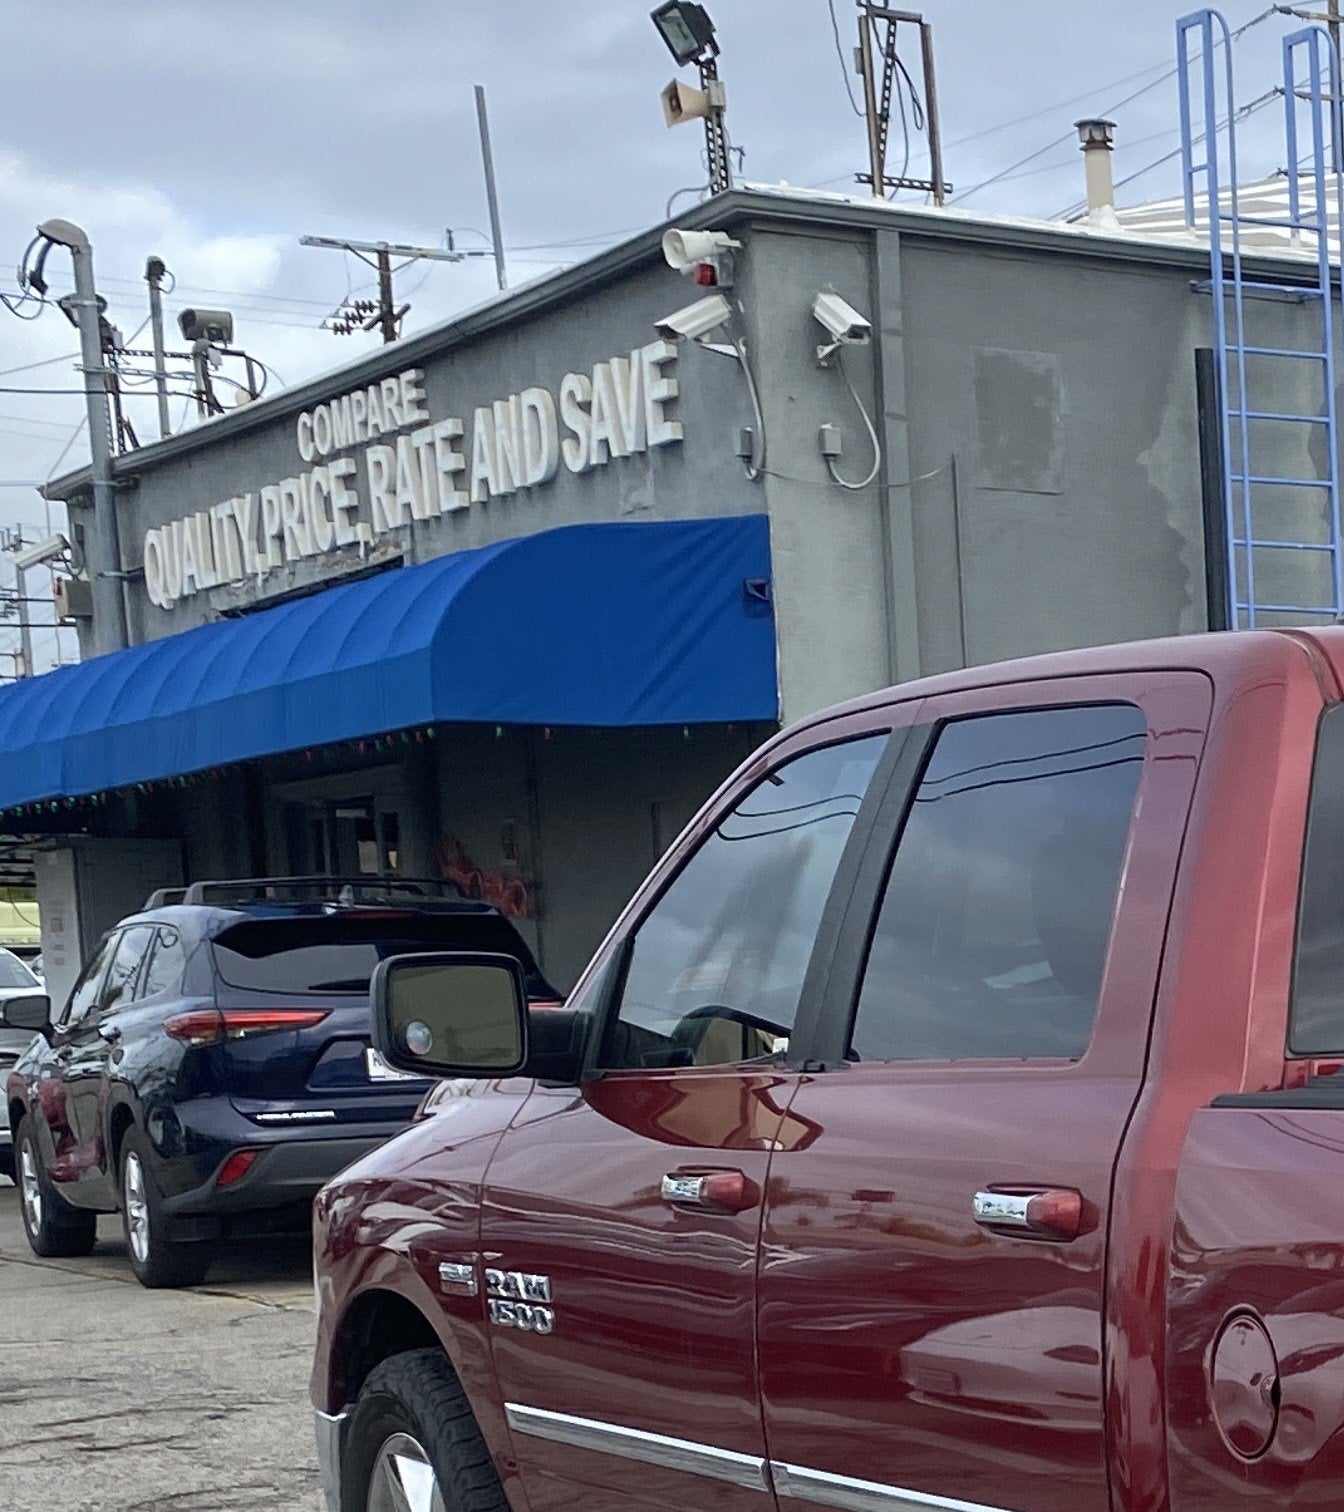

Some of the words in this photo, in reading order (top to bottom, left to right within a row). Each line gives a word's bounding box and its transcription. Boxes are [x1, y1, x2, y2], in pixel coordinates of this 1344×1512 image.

[297, 368, 430, 462] COMPARE
[260, 457, 374, 559] PRICE,
[366, 418, 470, 532] RATE
[471, 387, 560, 502] AND
[560, 339, 684, 473] SAVE
[484, 1267, 552, 1303] RAM
[487, 1298, 556, 1335] 1500
